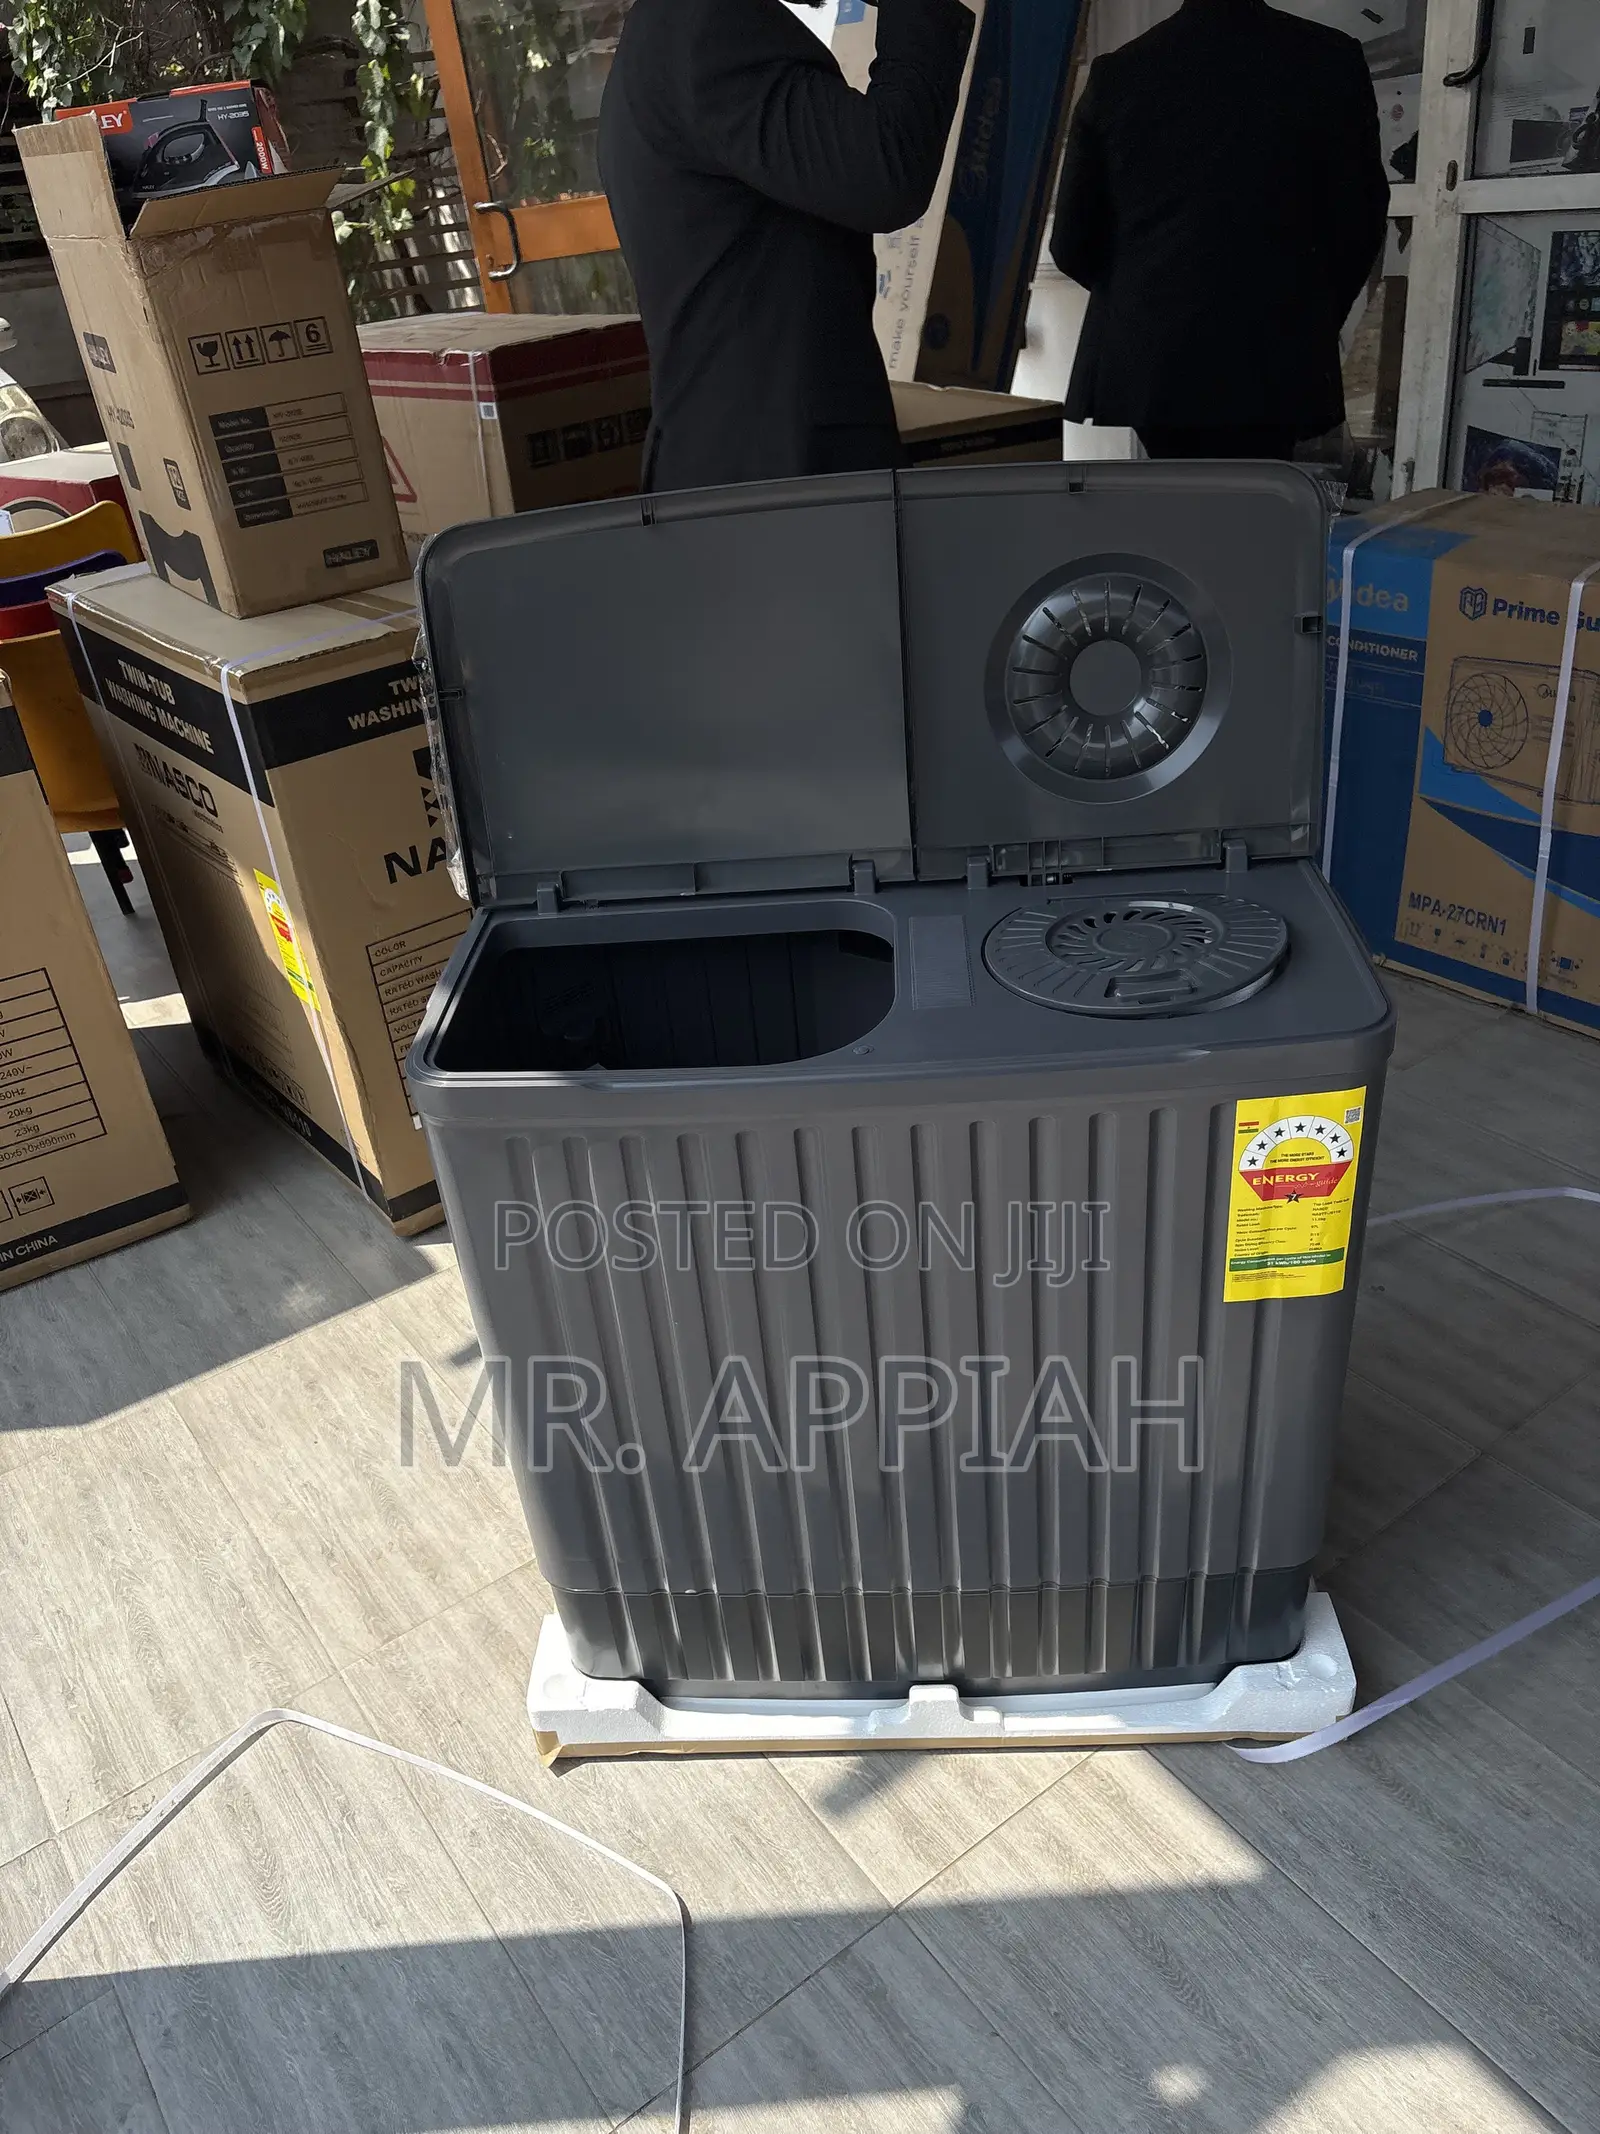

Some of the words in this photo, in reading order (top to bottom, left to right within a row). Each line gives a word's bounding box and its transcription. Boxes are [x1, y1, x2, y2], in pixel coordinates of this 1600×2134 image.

[100, 112, 123, 129] EY
[257, 141, 269, 170] 2000W
[887, 319, 906, 369] make
[900, 235, 921, 312] yourself
[305, 323, 322, 343] 6
[1327, 577, 1409, 613] Mdea
[1492, 597, 1561, 626] Prime
[117, 658, 176, 706] TWIN-TUB
[388, 675, 419, 696] TW
[105, 677, 158, 723] WASHING
[158, 706, 215, 755] MACHINE
[383, 836, 447, 885] NA
[1408, 891, 1507, 936] MPA-27CRN1
[374, 940, 407, 957] COLOR
[379, 955, 424, 978] CAPACITY
[384, 978, 415, 997] RATED
[416, 969, 442, 985] WASH
[389, 997, 419, 1016] RATED
[393, 1017, 423, 1035] VOLTA
[0, 1087, 26, 1101] 50Hz
[7, 1106, 33, 1119] 20kg
[14, 1124, 40, 1137] 23kg
[1252, 1172, 1320, 1186] ENERGY
[0, 1249, 14, 1263] IN
[15, 1235, 58, 1256] CHINA
